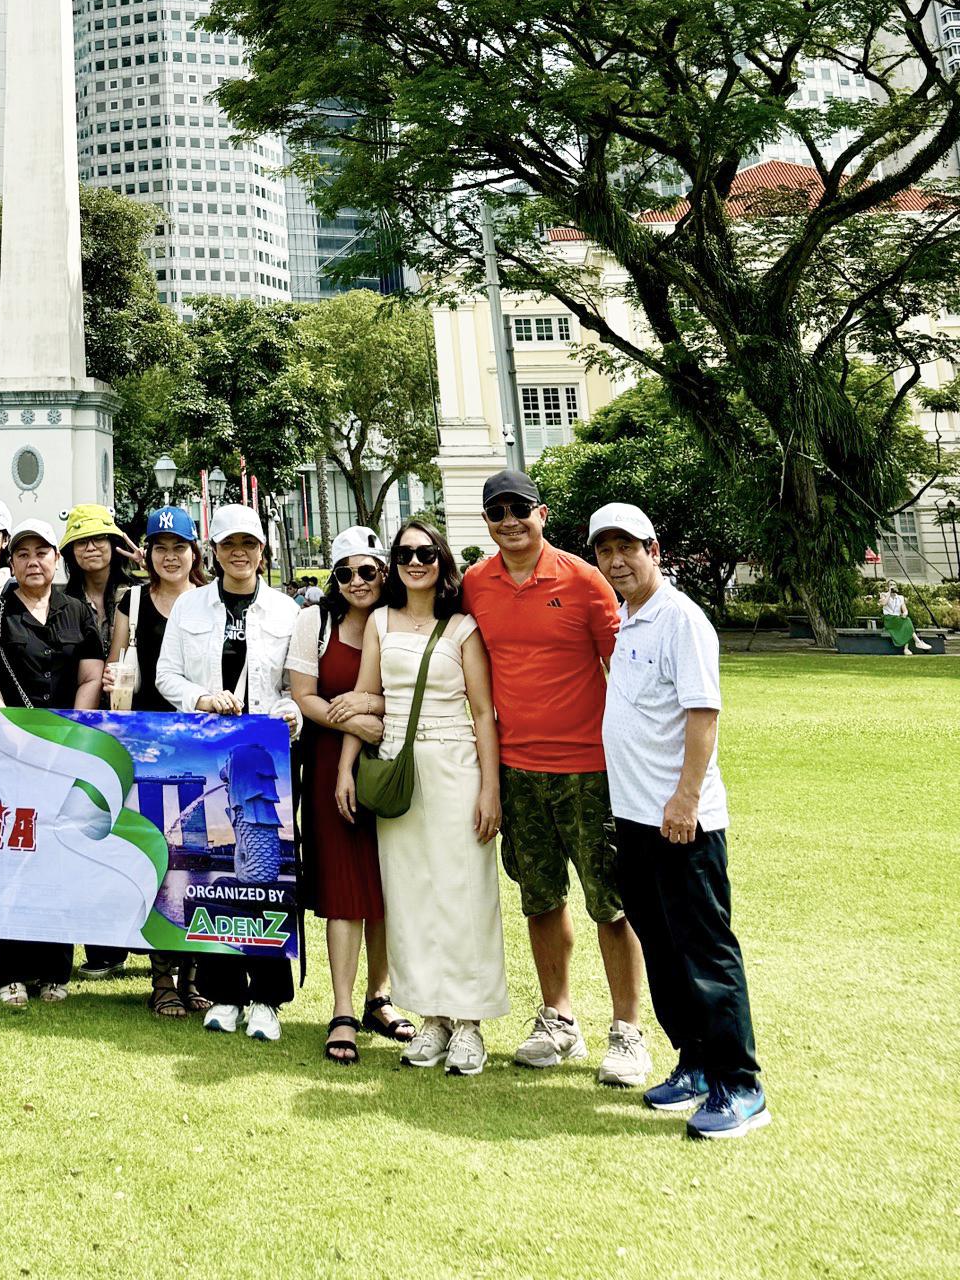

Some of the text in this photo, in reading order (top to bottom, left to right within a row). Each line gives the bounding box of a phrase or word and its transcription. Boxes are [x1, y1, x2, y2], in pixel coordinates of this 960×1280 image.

[158, 511, 174, 529] NY
[186, 885, 285, 903] ORGANIZED BY
